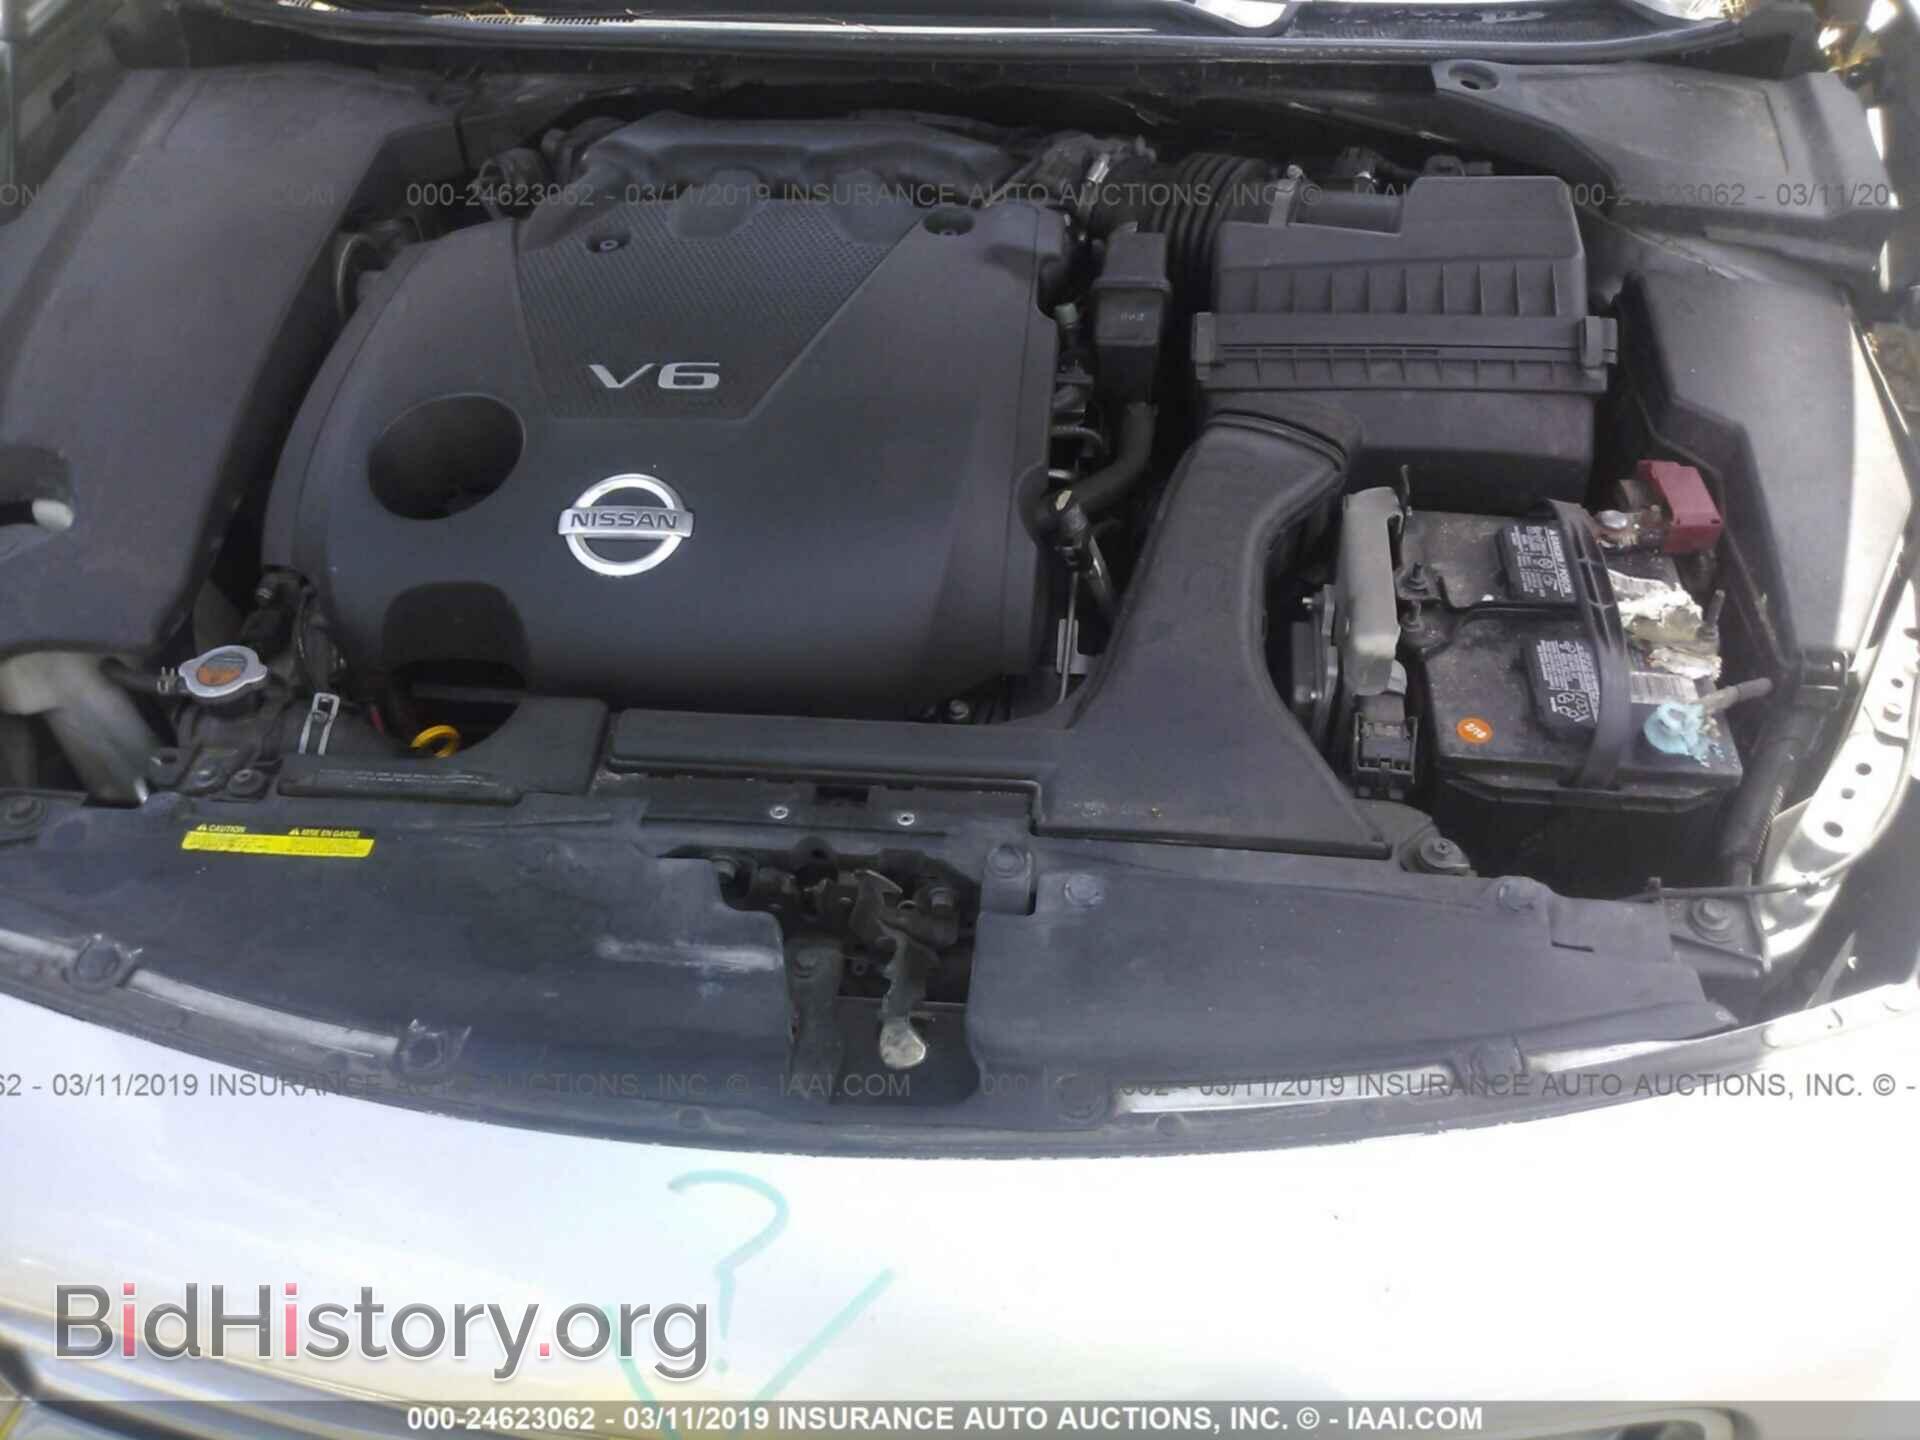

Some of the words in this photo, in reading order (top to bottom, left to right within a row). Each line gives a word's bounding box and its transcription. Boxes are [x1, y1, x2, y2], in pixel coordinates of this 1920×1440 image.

[588, 361, 721, 390] V6
[571, 512, 678, 529] NISSAN
[208, 824, 246, 834] CAUTION
